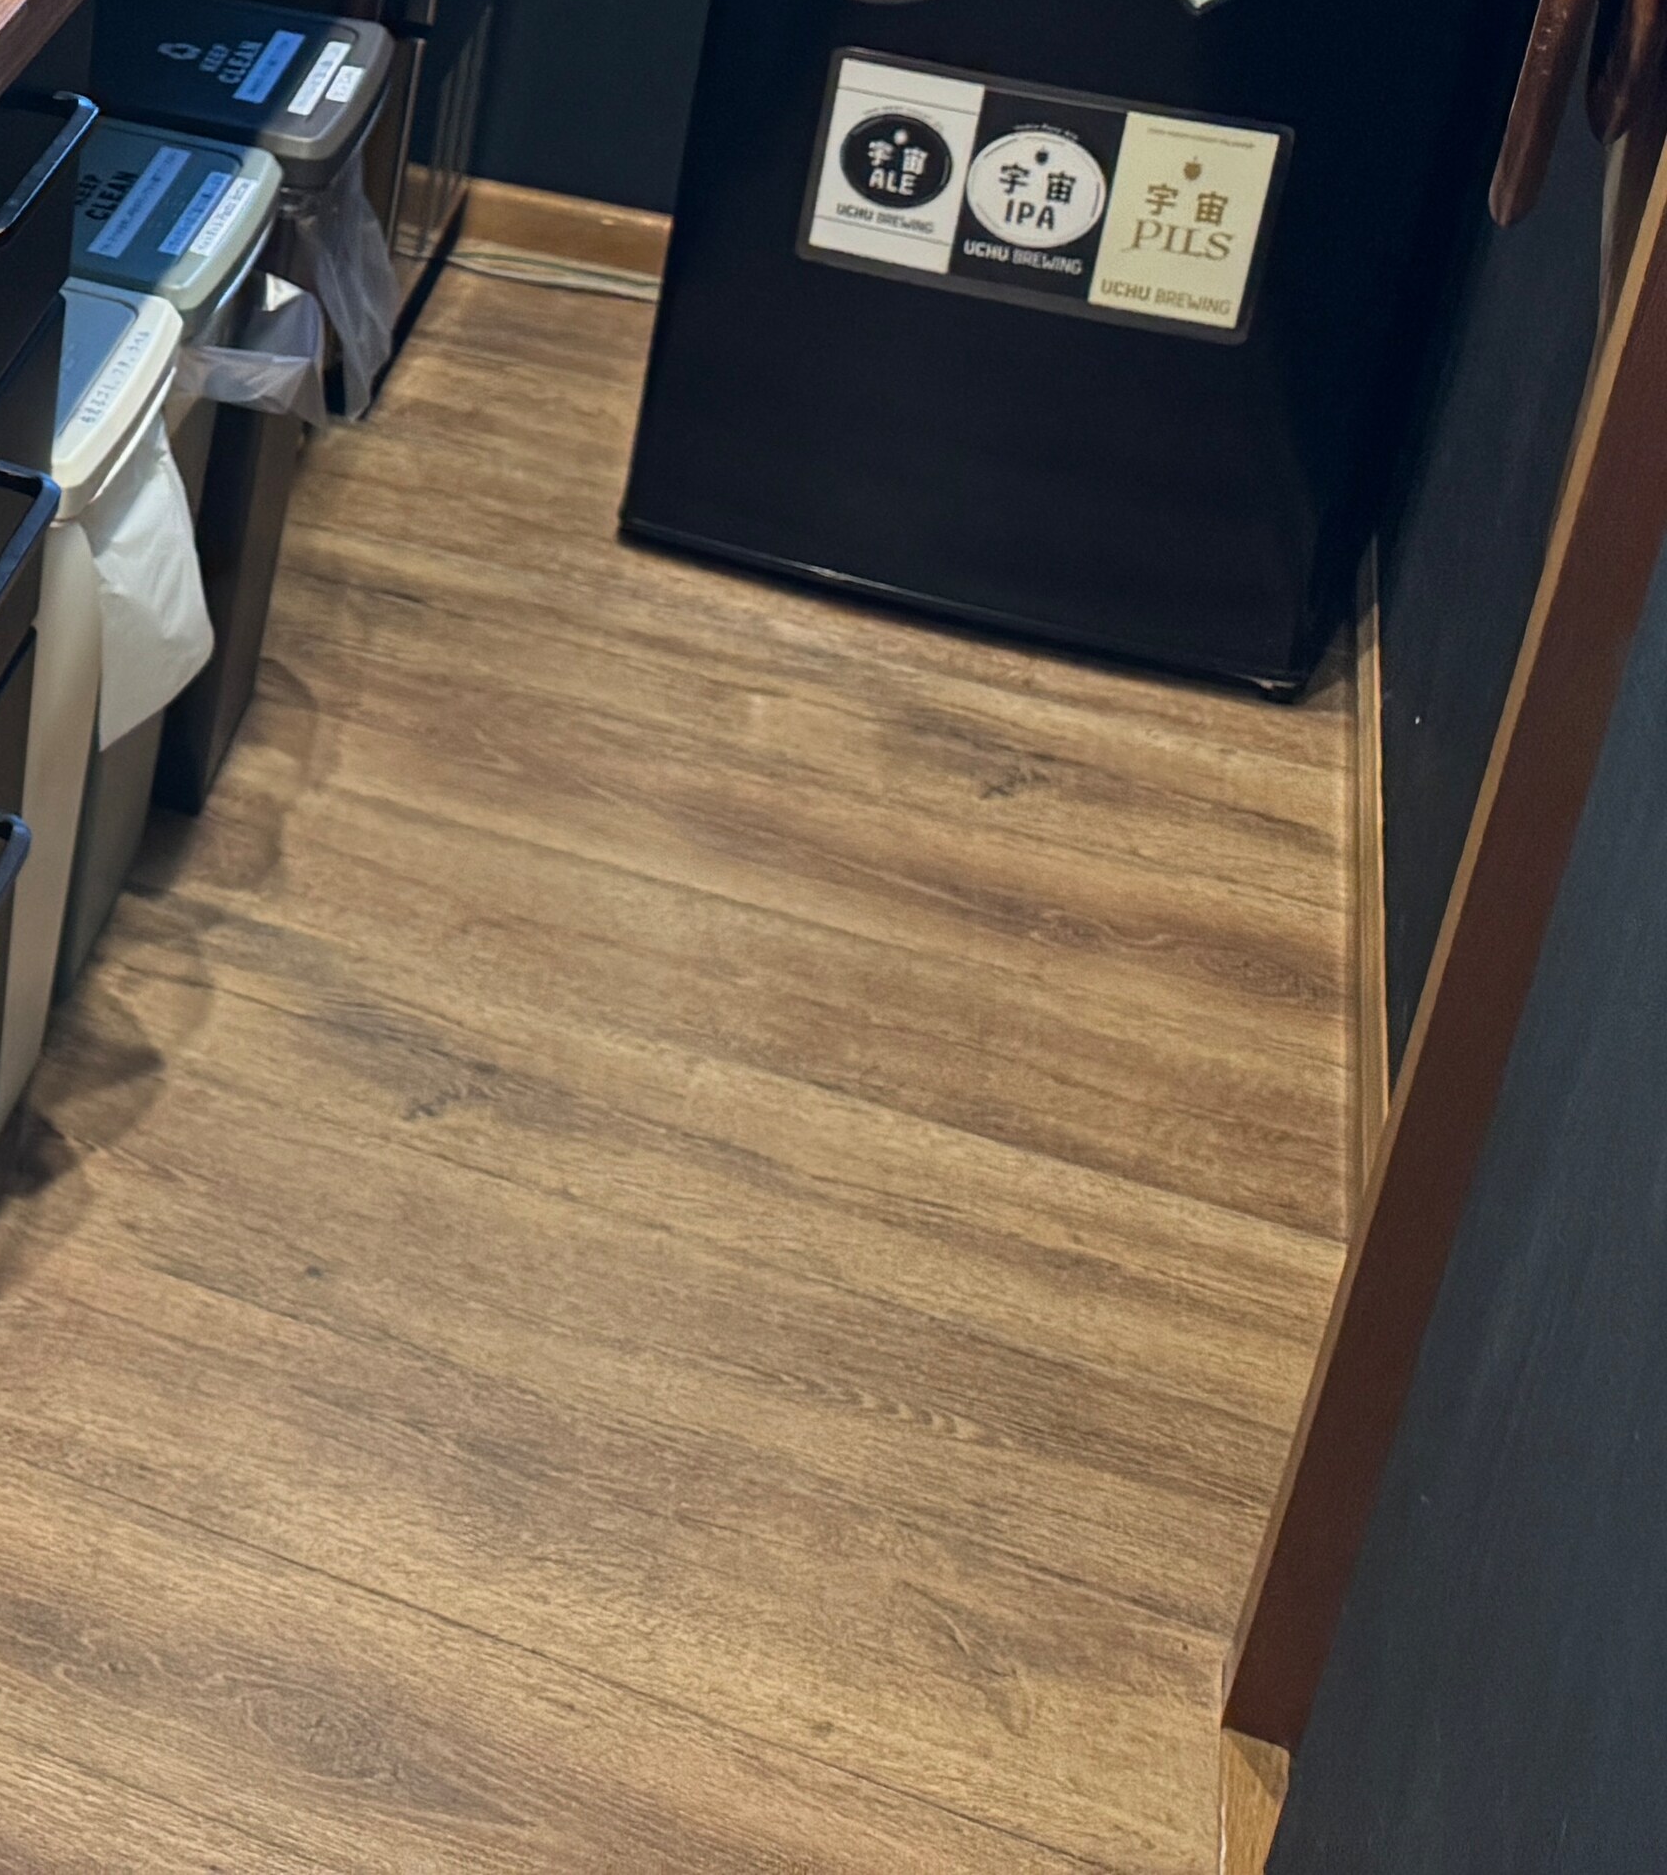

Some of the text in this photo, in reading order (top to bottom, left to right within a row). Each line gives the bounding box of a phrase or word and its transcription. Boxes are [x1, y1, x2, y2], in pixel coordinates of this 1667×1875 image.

[217, 40, 264, 85] CLEAN
[868, 139, 930, 175] 宇宙
[85, 171, 140, 221] CLEAN
[868, 168, 917, 196] ALE
[999, 163, 1077, 204] 宇宙
[836, 202, 935, 234] UCHU BREWING
[1005, 199, 1055, 230] IPA
[1146, 183, 1229, 226] 宇宙
[963, 239, 1083, 275] UCHU BREWING
[1121, 219, 1236, 261] PILS
[1101, 279, 1231, 315] UCHU BREWING
